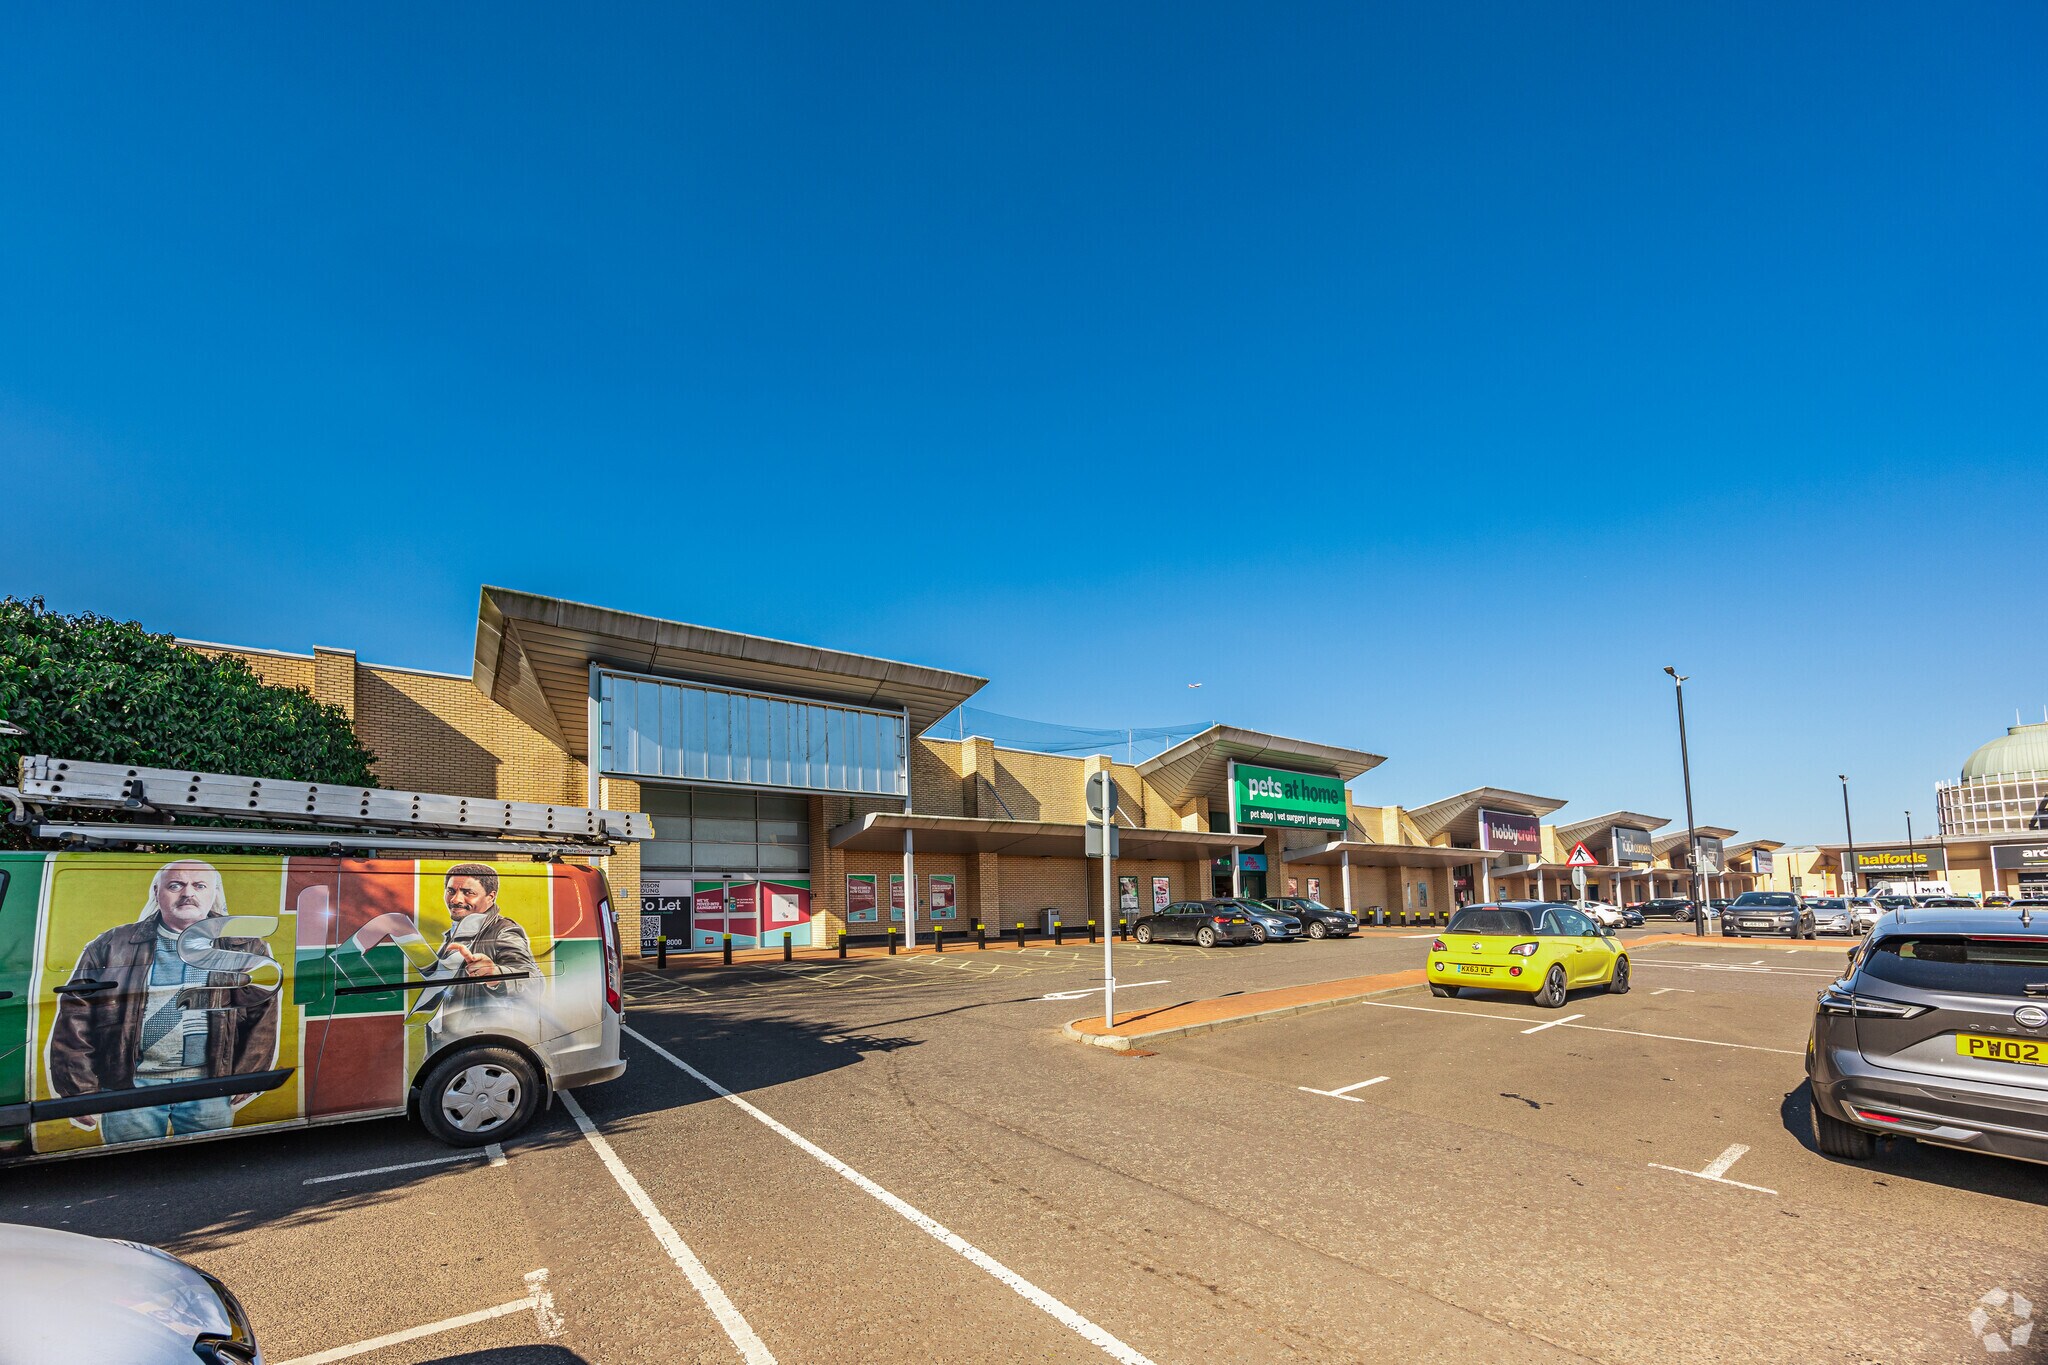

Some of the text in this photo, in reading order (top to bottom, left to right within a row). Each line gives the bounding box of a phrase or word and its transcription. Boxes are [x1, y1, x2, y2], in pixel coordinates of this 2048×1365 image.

[1248, 776, 1339, 804] pets at home
[1250, 810, 1340, 827] pet shop vet surgery pet grooming
[1491, 822, 1537, 845] hobbycraft
[2022, 846, 2048, 857] arc
[1858, 852, 1928, 865] halfords
[641, 898, 681, 911] To Let
[1968, 1023, 2048, 1035] QASH
